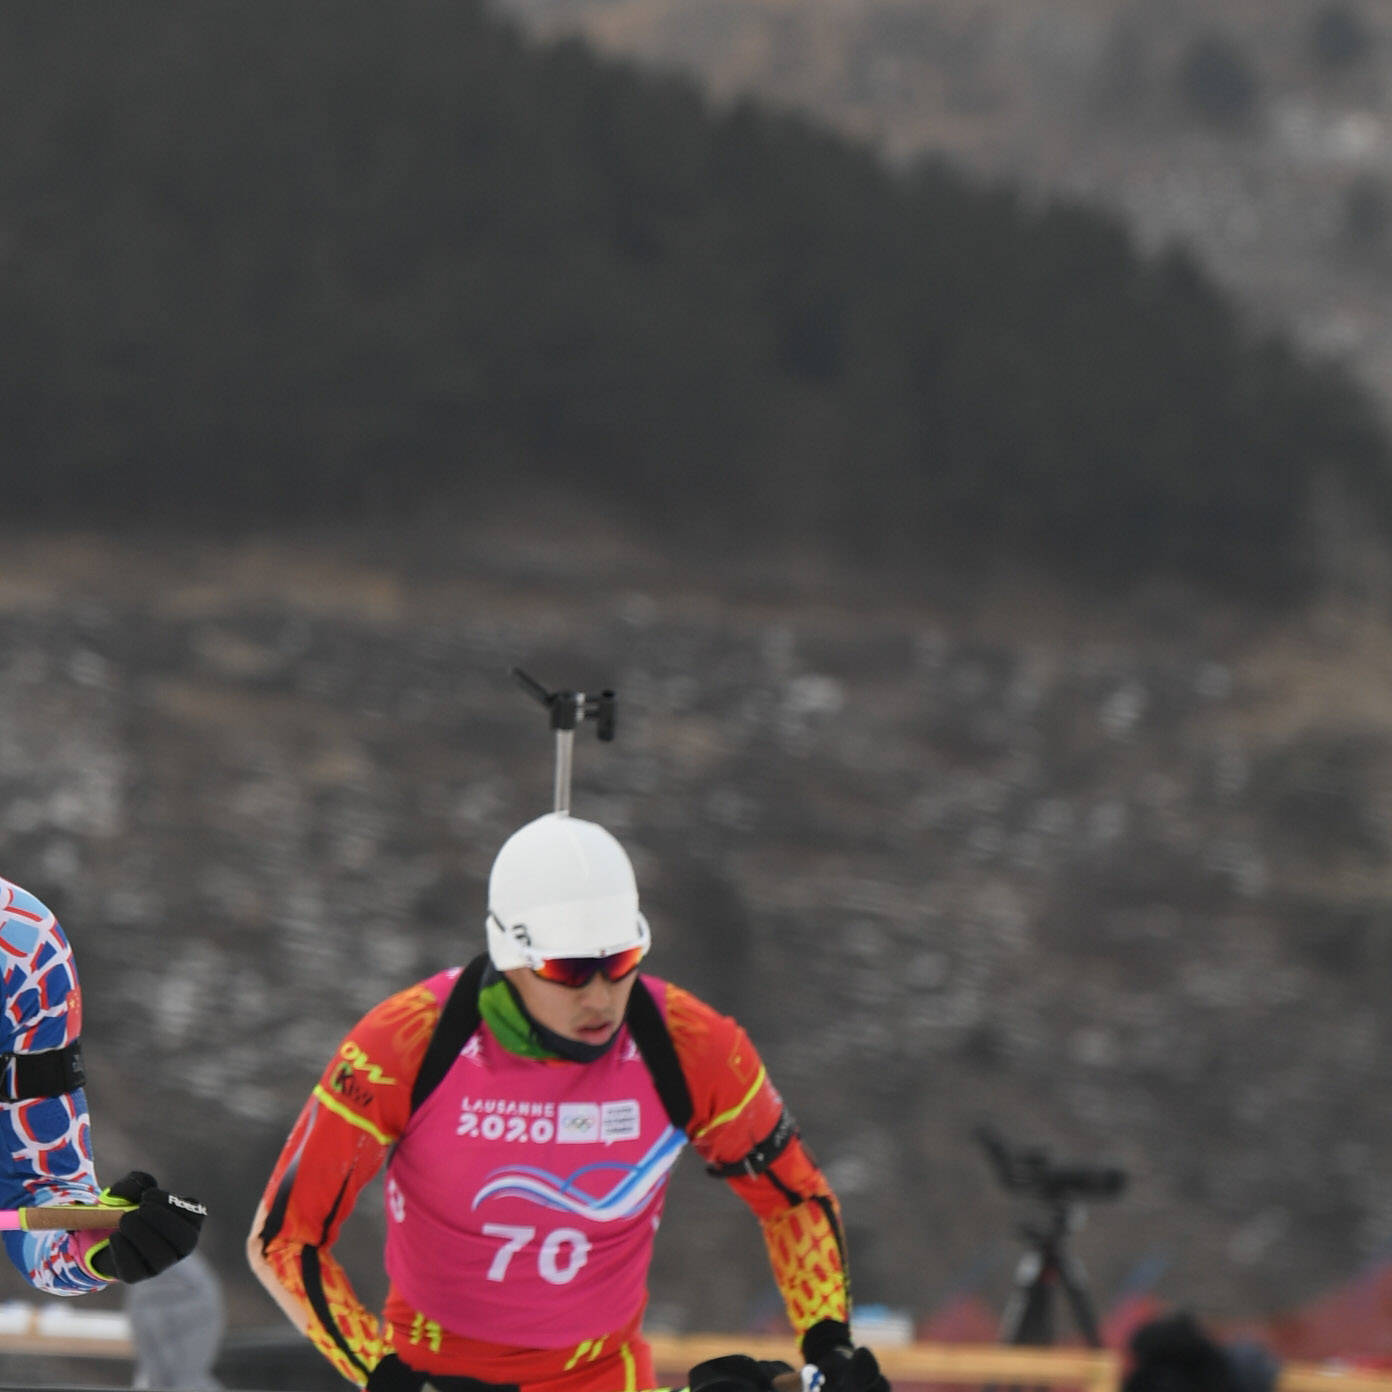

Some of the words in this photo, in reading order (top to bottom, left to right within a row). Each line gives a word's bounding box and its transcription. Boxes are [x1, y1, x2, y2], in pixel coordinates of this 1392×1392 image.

[461, 1097, 555, 1117] LAUSANNE
[456, 1112, 554, 1144] 2020
[481, 1222, 593, 1286] 70
